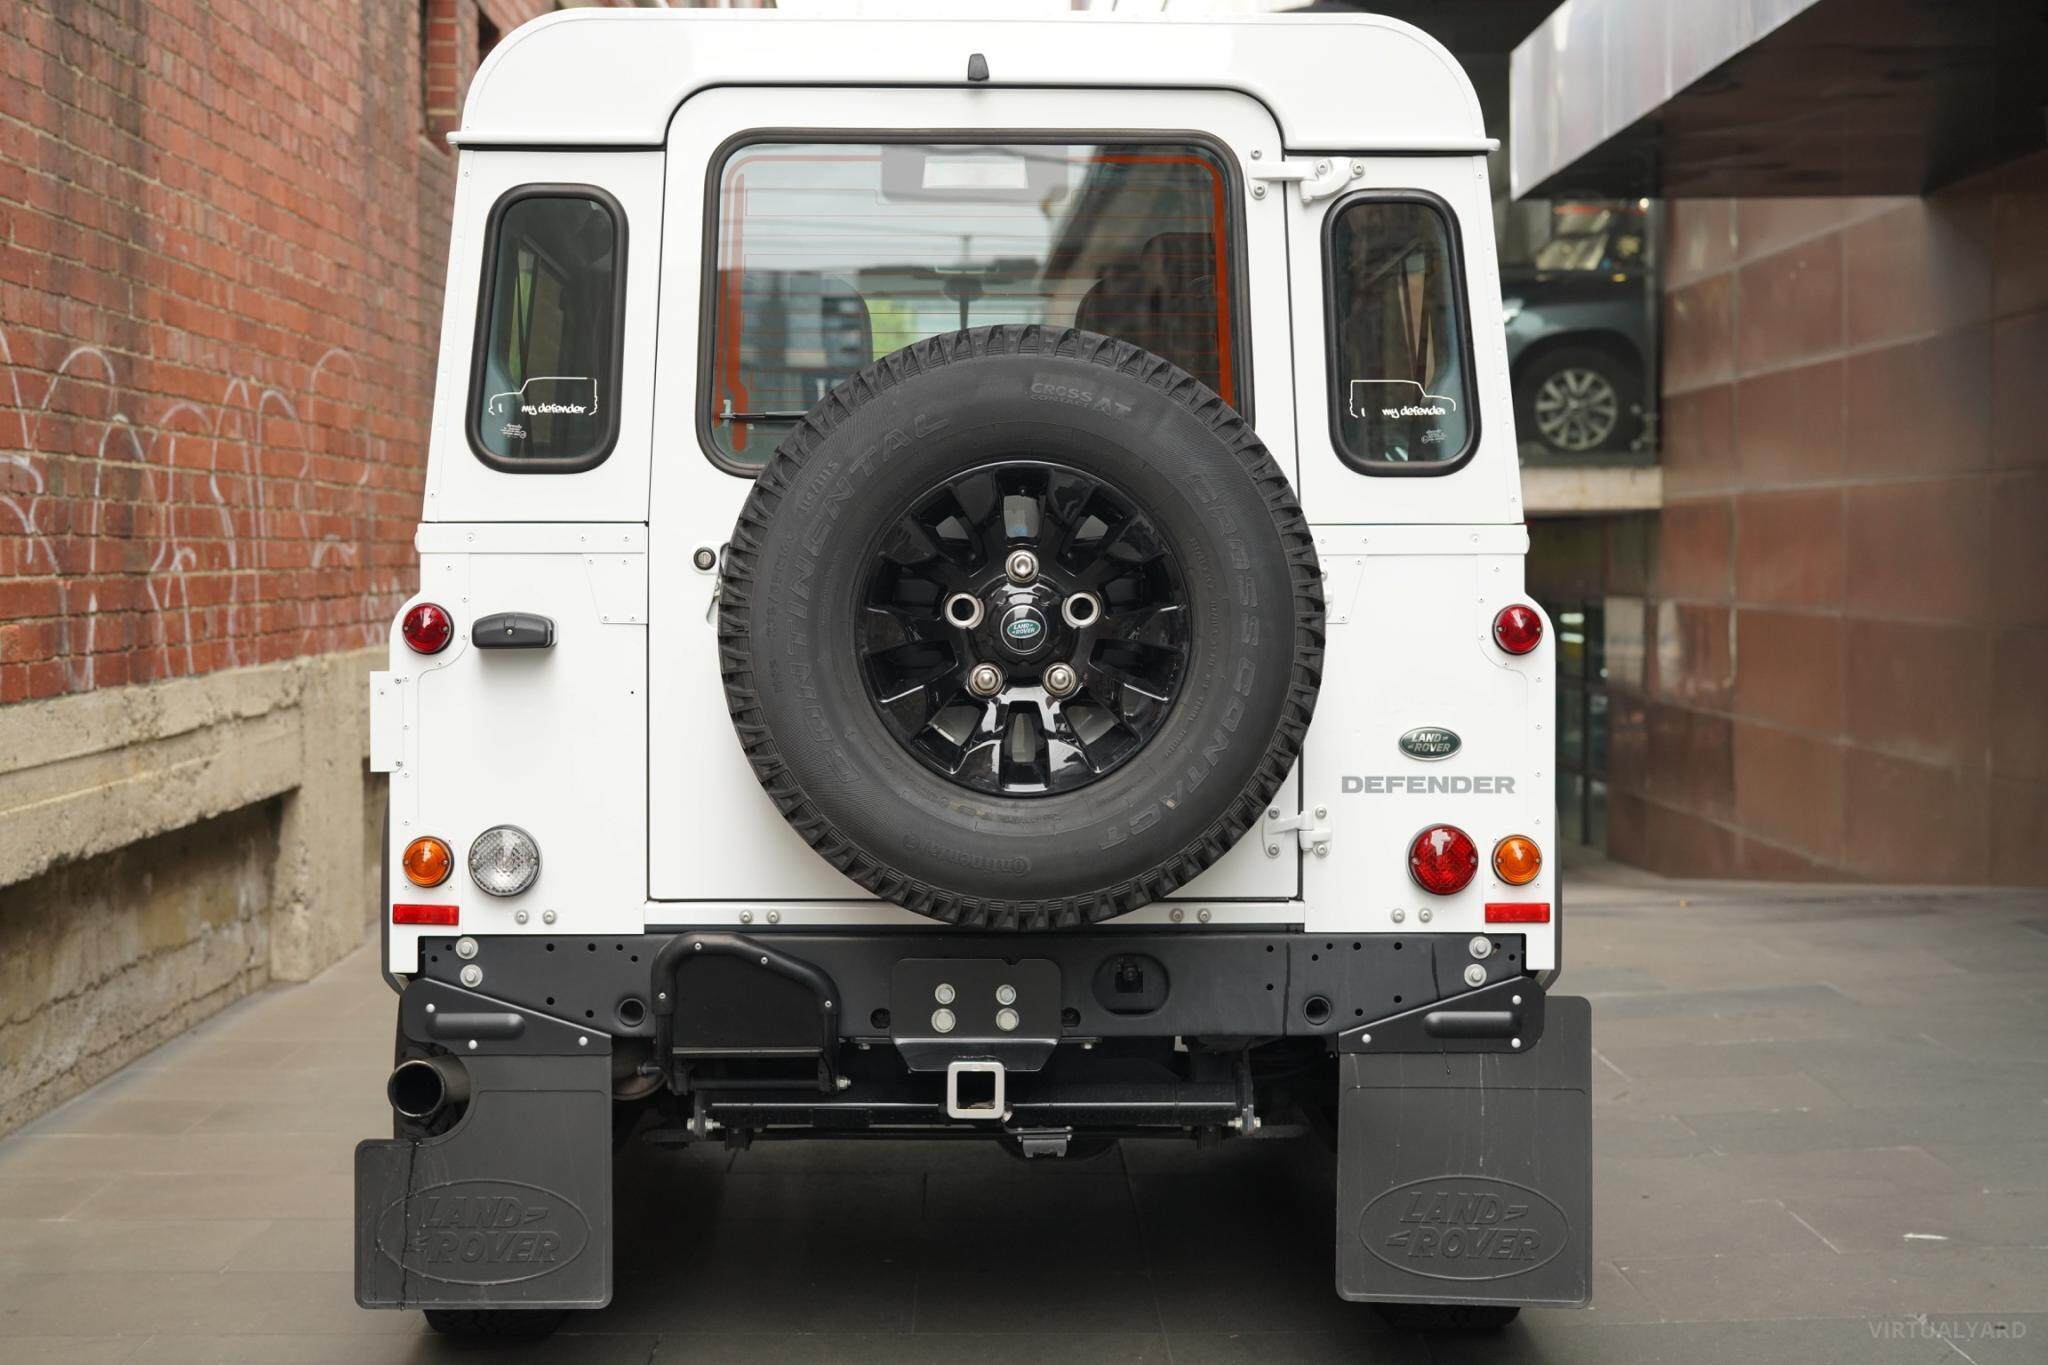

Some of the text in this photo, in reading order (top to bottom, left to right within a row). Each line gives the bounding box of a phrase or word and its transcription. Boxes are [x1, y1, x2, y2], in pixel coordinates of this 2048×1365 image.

[1030, 382, 1093, 402] CROSS
[521, 405, 537, 416] my
[538, 403, 588, 414] defender
[1382, 408, 1399, 418] my
[1400, 405, 1446, 416] defender
[784, 413, 949, 784] CONTINENTAL
[1411, 733, 1441, 742] LAND
[1414, 743, 1450, 752] ROVER
[1100, 656, 1257, 850] CONTACT
[1341, 776, 1516, 794] DEFENDER
[420, 1196, 521, 1229] LAND
[1400, 1192, 1501, 1225] LAND
[427, 1230, 561, 1263] ROVER
[1407, 1226, 1542, 1261] ROVER
